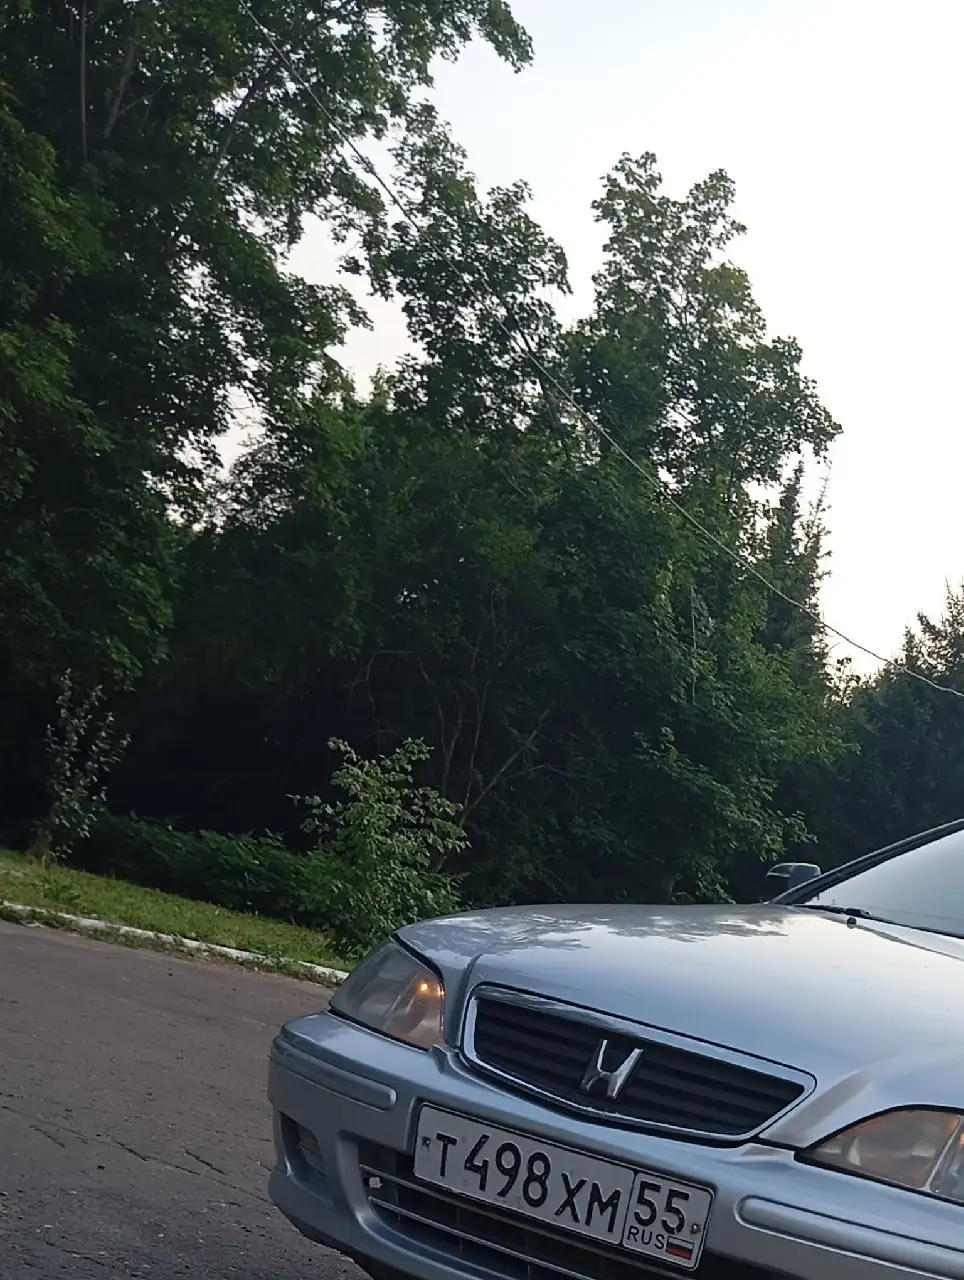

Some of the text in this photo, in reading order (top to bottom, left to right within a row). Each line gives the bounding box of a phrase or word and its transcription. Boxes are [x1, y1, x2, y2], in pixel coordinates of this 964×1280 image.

[580, 1039, 644, 1099] H
[633, 1180, 690, 1235] 55
[626, 1225, 666, 1250] RUS
